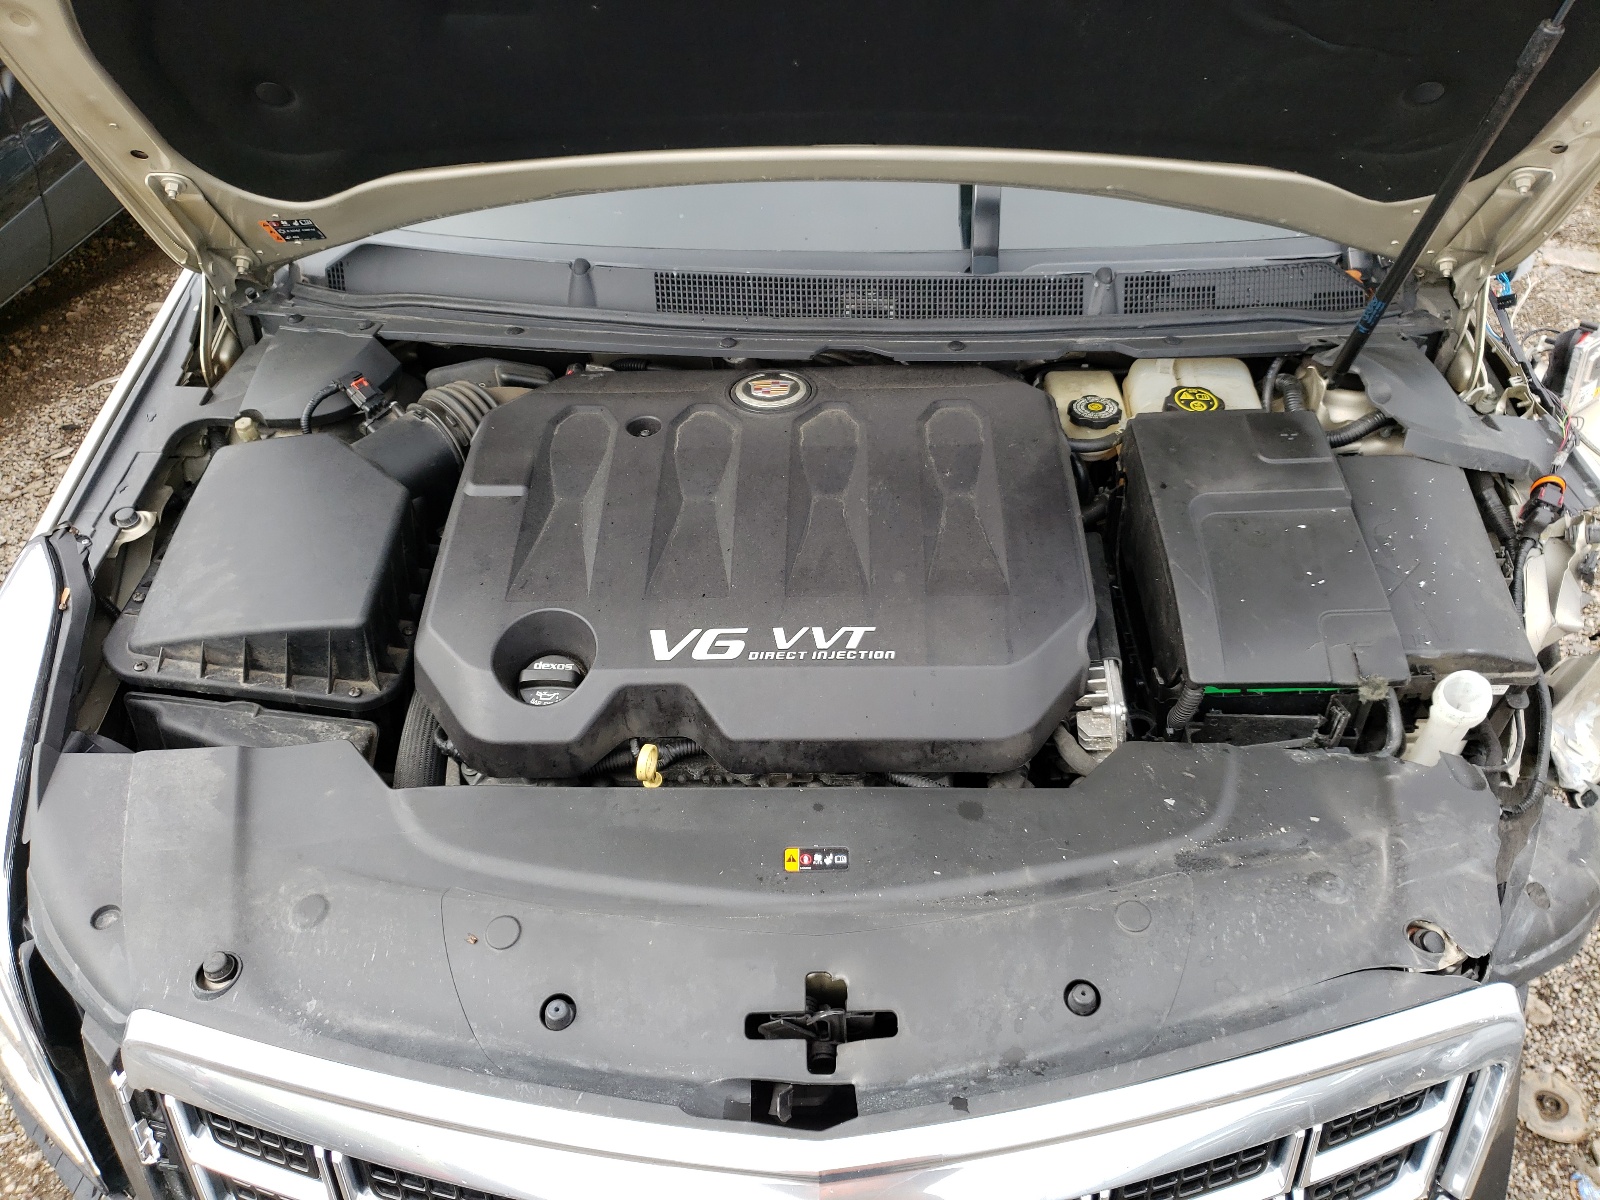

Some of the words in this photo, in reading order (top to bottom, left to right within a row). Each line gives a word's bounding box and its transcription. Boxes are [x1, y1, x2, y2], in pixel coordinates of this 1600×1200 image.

[649, 627, 749, 661] V6
[772, 626, 877, 650] VVT
[748, 650, 807, 661] DIRECT
[811, 650, 896, 660] INJECTION
[533, 661, 575, 671] dexos
